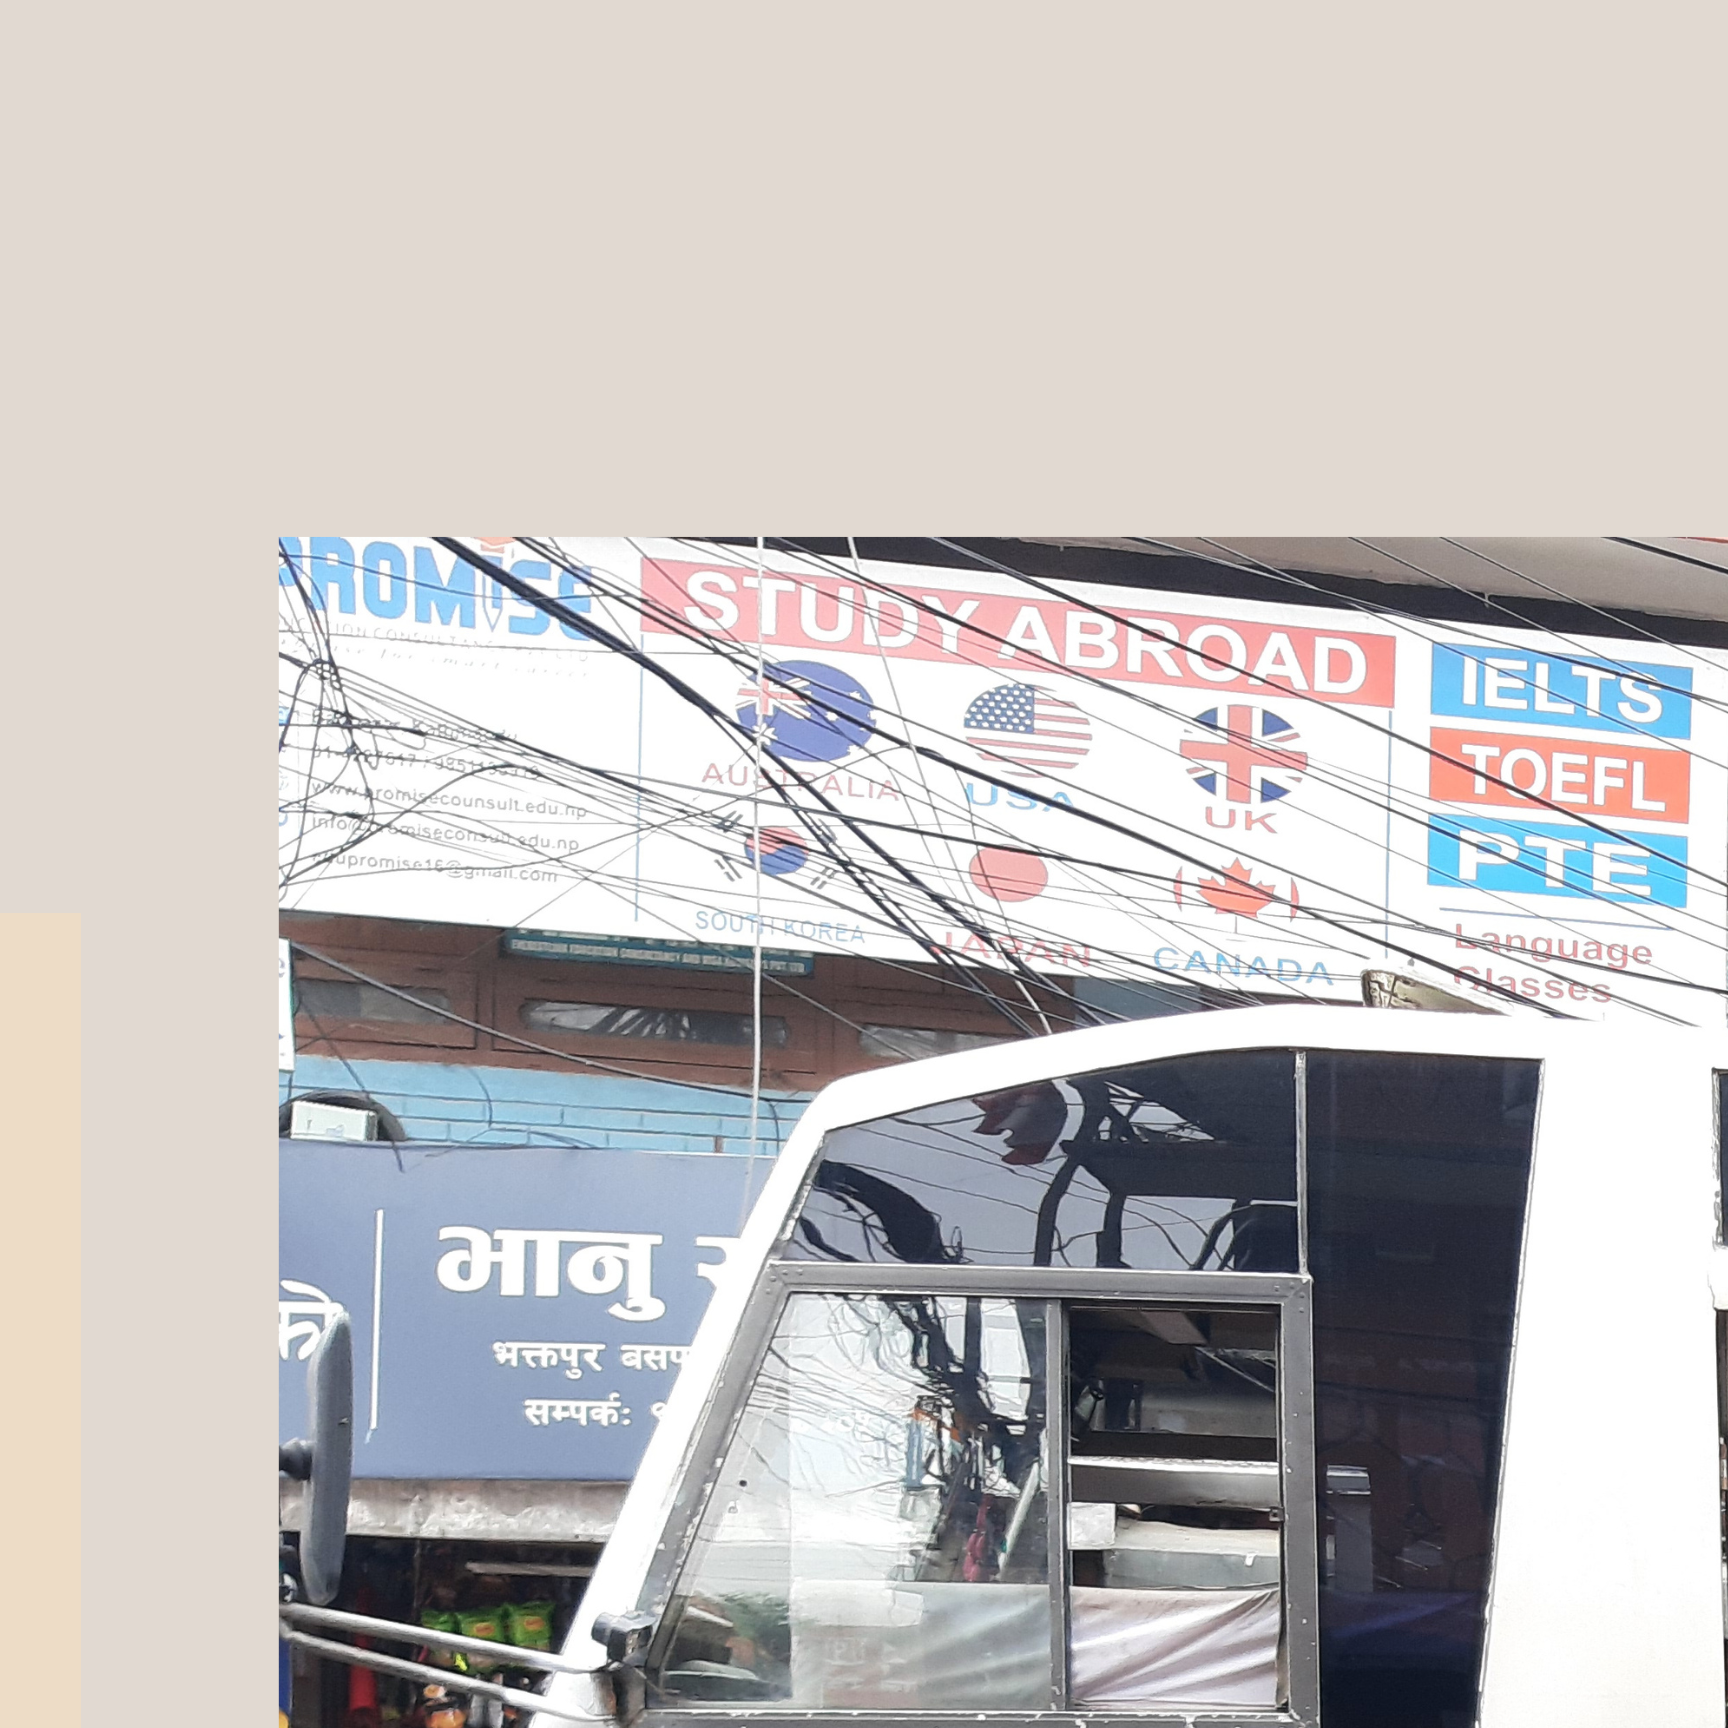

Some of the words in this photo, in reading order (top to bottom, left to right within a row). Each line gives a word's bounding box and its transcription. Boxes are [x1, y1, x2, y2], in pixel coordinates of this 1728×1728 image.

[684, 569, 980, 651] STUDY
[997, 597, 1368, 695] ABROAD
[1462, 655, 1664, 724] IELTS
[702, 762, 899, 802] AUSTRALIA
[965, 782, 1075, 813] USA
[1461, 743, 1667, 813] TOEFL
[1205, 806, 1278, 834] UK
[1458, 829, 1652, 897] PTE
[695, 910, 774, 938] SOUTH
[784, 920, 866, 944] KOREA
[1455, 923, 1653, 970] Language
[929, 930, 1091, 967] JAPAN
[1153, 946, 1334, 987] CANADA
[1453, 965, 1612, 1003] Classes
[436, 1225, 667, 1322] भानु
[492, 1341, 607, 1380] भक्तपुर
